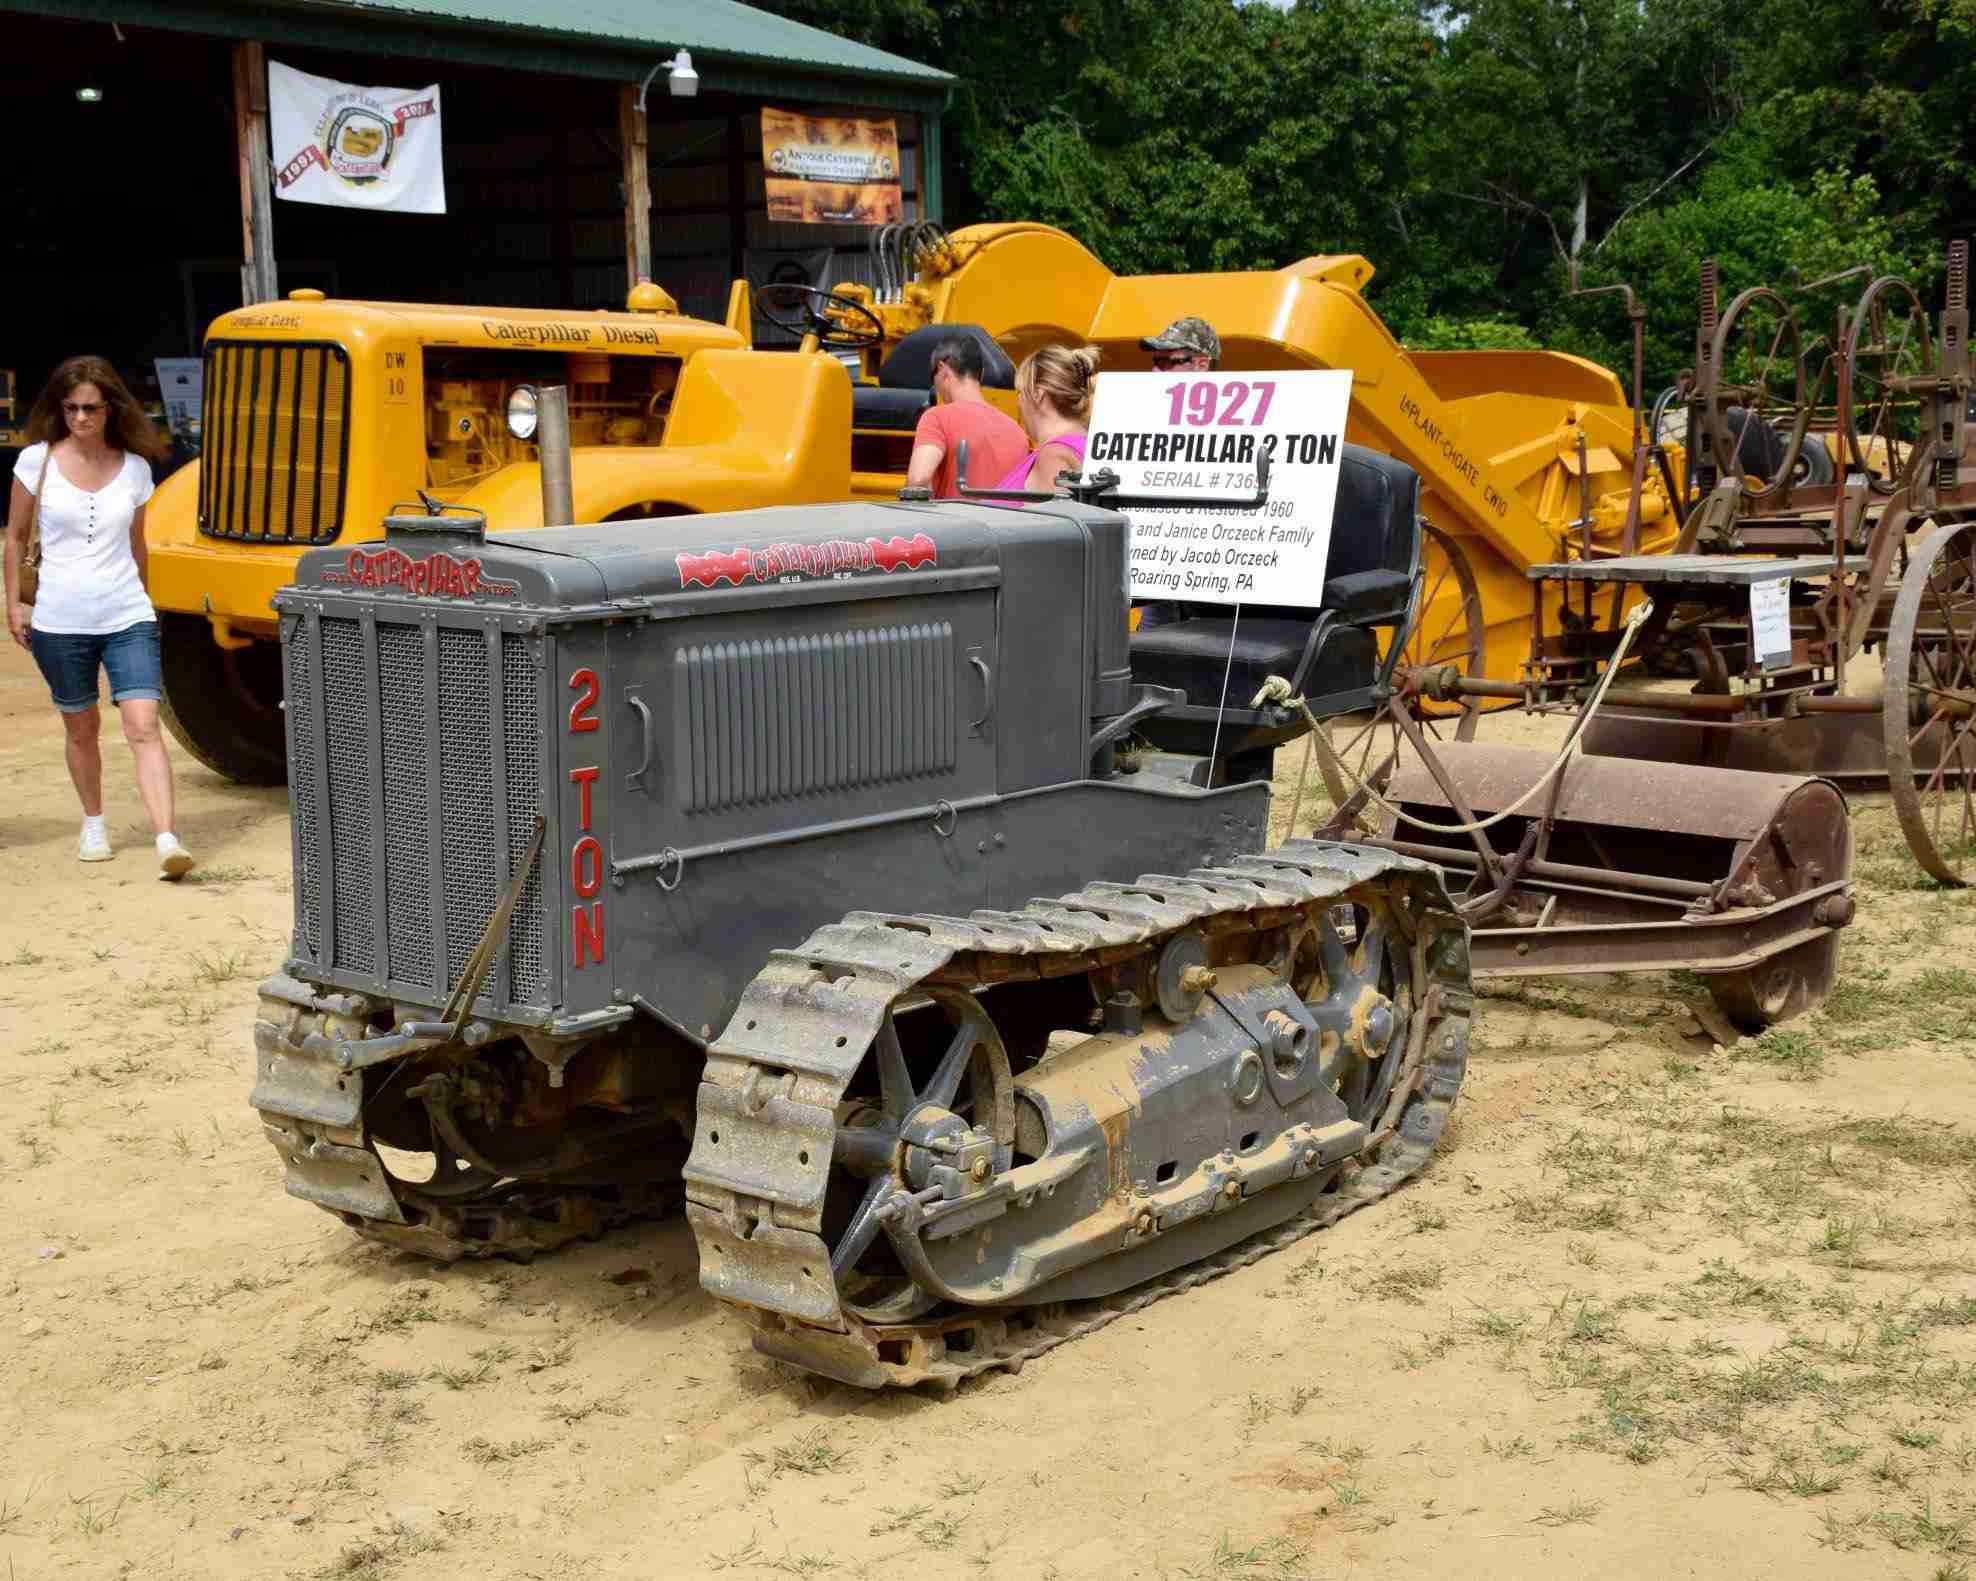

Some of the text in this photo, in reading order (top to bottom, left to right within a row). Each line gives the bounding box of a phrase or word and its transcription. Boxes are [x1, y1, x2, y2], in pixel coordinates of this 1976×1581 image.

[284, 149, 316, 182] 1991
[481, 321, 661, 345] Caterpillar Diesel
[385, 351, 407, 369] DW
[389, 378, 405, 396] 10
[1165, 381, 1276, 426] 1927
[1091, 432, 1338, 464] CATERPILLAR 2 TON
[1142, 471, 1203, 488] SERIAL
[1208, 473, 1220, 488] #
[1264, 501, 1294, 518] 1960
[1136, 521, 1315, 548] and Janice Orczeck Family
[1161, 545, 1178, 566] by
[1180, 547, 1221, 565] Jacob
[1225, 548, 1279, 568] Orczeck
[347, 549, 482, 596] CATERPILLAR
[1130, 567, 1254, 593] Roaring Spring, PA
[568, 668, 604, 969] 2 TON
